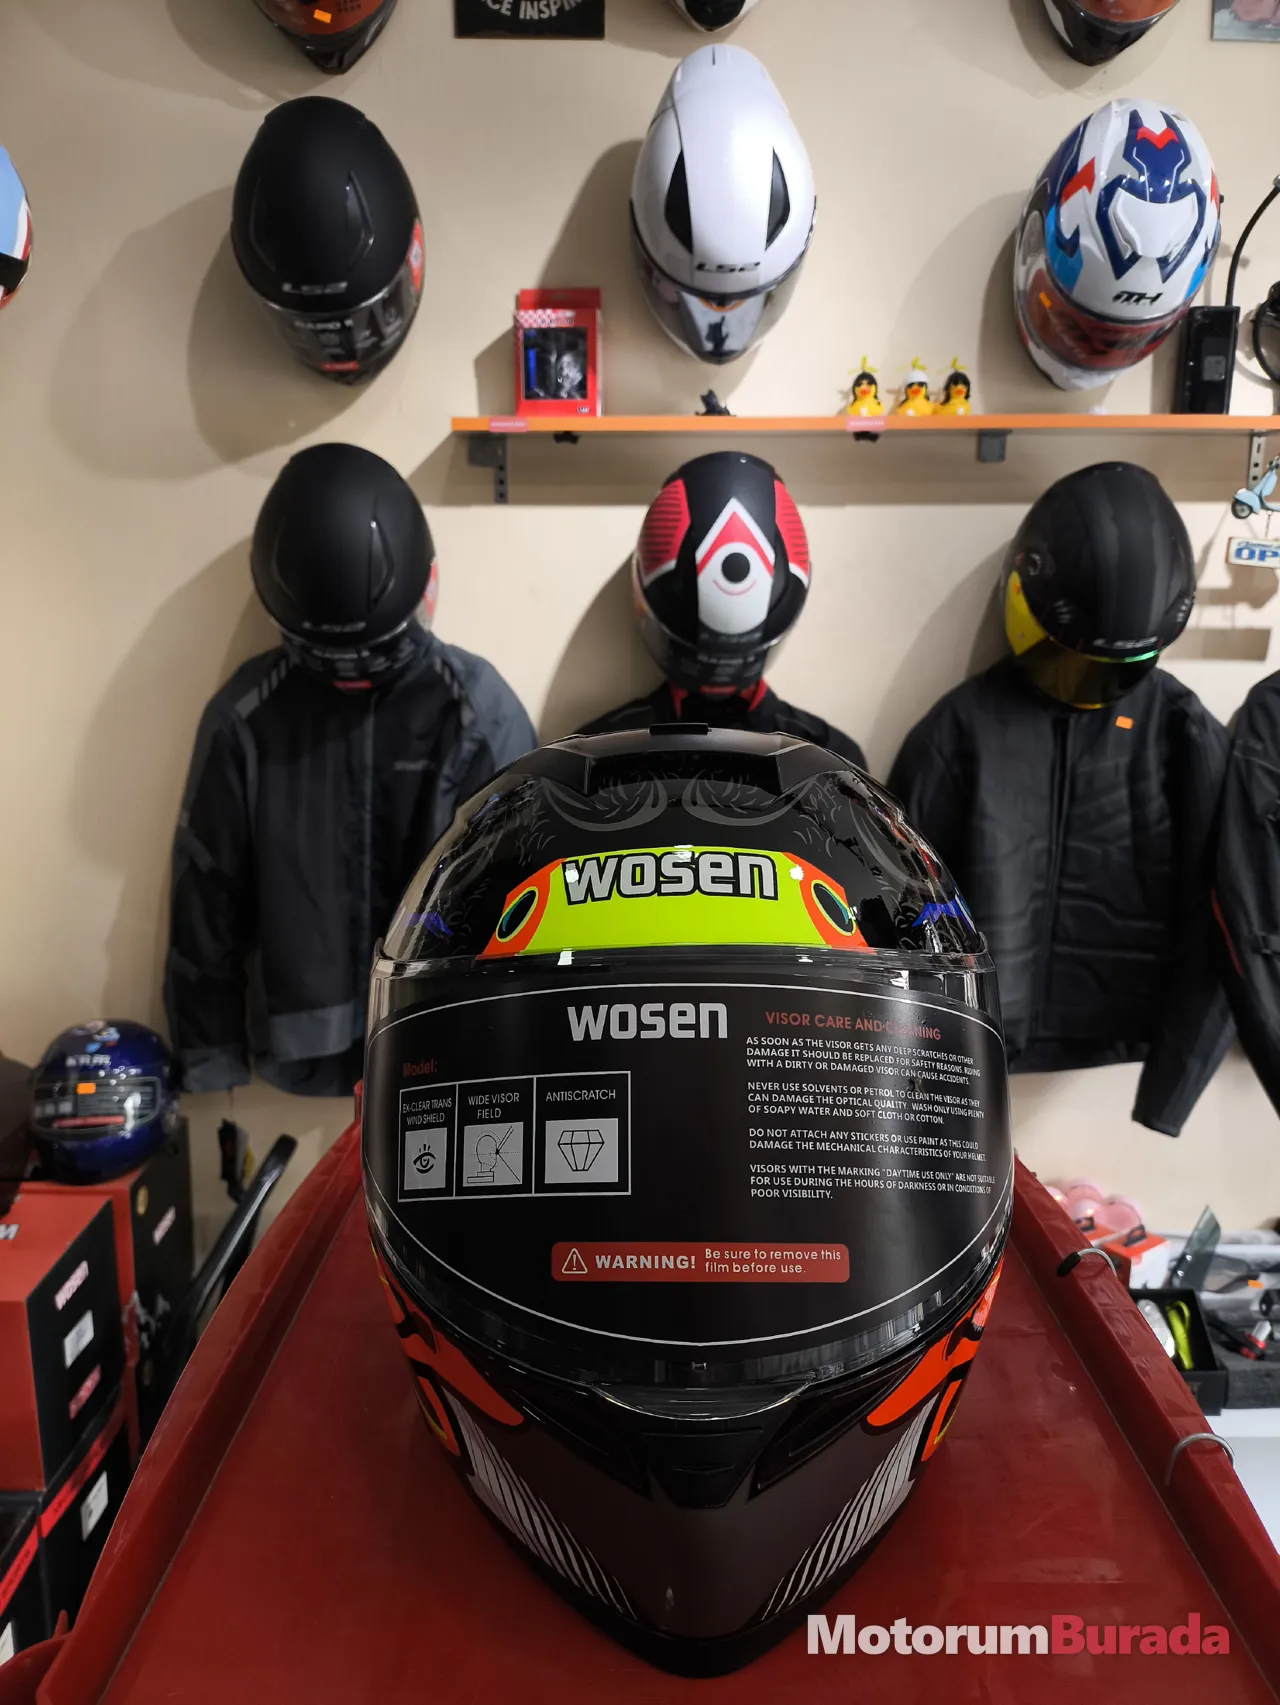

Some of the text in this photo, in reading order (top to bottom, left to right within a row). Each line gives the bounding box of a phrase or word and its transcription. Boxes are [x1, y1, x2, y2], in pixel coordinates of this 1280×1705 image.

[1235, 547, 1280, 562] OP
[765, 1012, 810, 1026] VISOR
[814, 1014, 852, 1029] CARE
[854, 1018, 883, 1032] AND
[746, 1036, 974, 1065] AS SOON AS THE VISOR GETS ANY DEEP SCRATCHES OR OTHER
[746, 1048, 789, 1057] DAMAGE
[791, 1049, 800, 1057] IT
[802, 1050, 840, 1059] SHOULD
[842, 1052, 852, 1060] BE
[854, 1053, 894, 1064] REPLACED
[896, 1057, 911, 1066] FOR
[912, 1059, 936, 1070] SAFETY
[403, 1058, 438, 1077] Model:
[747, 1059, 774, 1068] WITH
[776, 1060, 783, 1068] A
[785, 1060, 813, 1070] DIRTY
[815, 1062, 828, 1070] OR
[830, 1062, 874, 1073] DAMAGED
[876, 1065, 899, 1075] VISOR
[900, 1068, 916, 1077] CAN
[917, 1070, 938, 1080] CAUSE
[468, 1092, 520, 1106] WIDE VISOR
[546, 1089, 616, 1102] ANTISCRATCH
[747, 1082, 980, 1108] NEVER USE SOLVENTS OR PETROL TO CLEAN THE VISOR AS THEY
[403, 1097, 452, 1114] EX-CLEAR TRANS
[477, 1108, 501, 1119] FIELD
[748, 1093, 985, 1119] CAN DAMAGE THE OPTICAL QUALITY. WASH ONLY USING PLENTY
[748, 1105, 944, 1124] OF SOAPY WATER AND SOFT CLOTH OR COTTON.
[749, 1128, 979, 1150] DO NOT ATTACH ANY STICKERS OR USE PAINT AS THIS COULD
[749, 1140, 794, 1150] DAMAGE
[795, 1141, 814, 1150] THE
[816, 1142, 876, 1153] MECHANICAL
[877, 1145, 942, 1158] CHARACTERISTICS
[943, 1150, 951, 1158] OF
[952, 1151, 968, 1160] YOUR
[750, 1164, 786, 1173] VISORS
[788, 1165, 815, 1174] WITH
[817, 1166, 836, 1175] THE
[838, 1166, 880, 1176] MARKING
[921, 1170, 934, 1180] USE
[955, 1173, 966, 1182] ARE
[967, 1174, 977, 1182] NOT
[750, 1176, 771, 1185] FOR
[773, 1177, 792, 1186] USE
[794, 1177, 833, 1187] DURING
[835, 1178, 852, 1187] THE
[854, 1179, 884, 1189] HOURS
[886, 1181, 897, 1189] OF
[898, 1181, 936, 1191] DARKNESS
[937, 1183, 946, 1192] OR
[947, 1184, 954, 1192] IN
[751, 1188, 833, 1199] POOR VISIBILITY.
[595, 1255, 696, 1269] WARNING!
[705, 1248, 841, 1260] Be sure to remove this
[705, 1262, 806, 1273] film before use.
